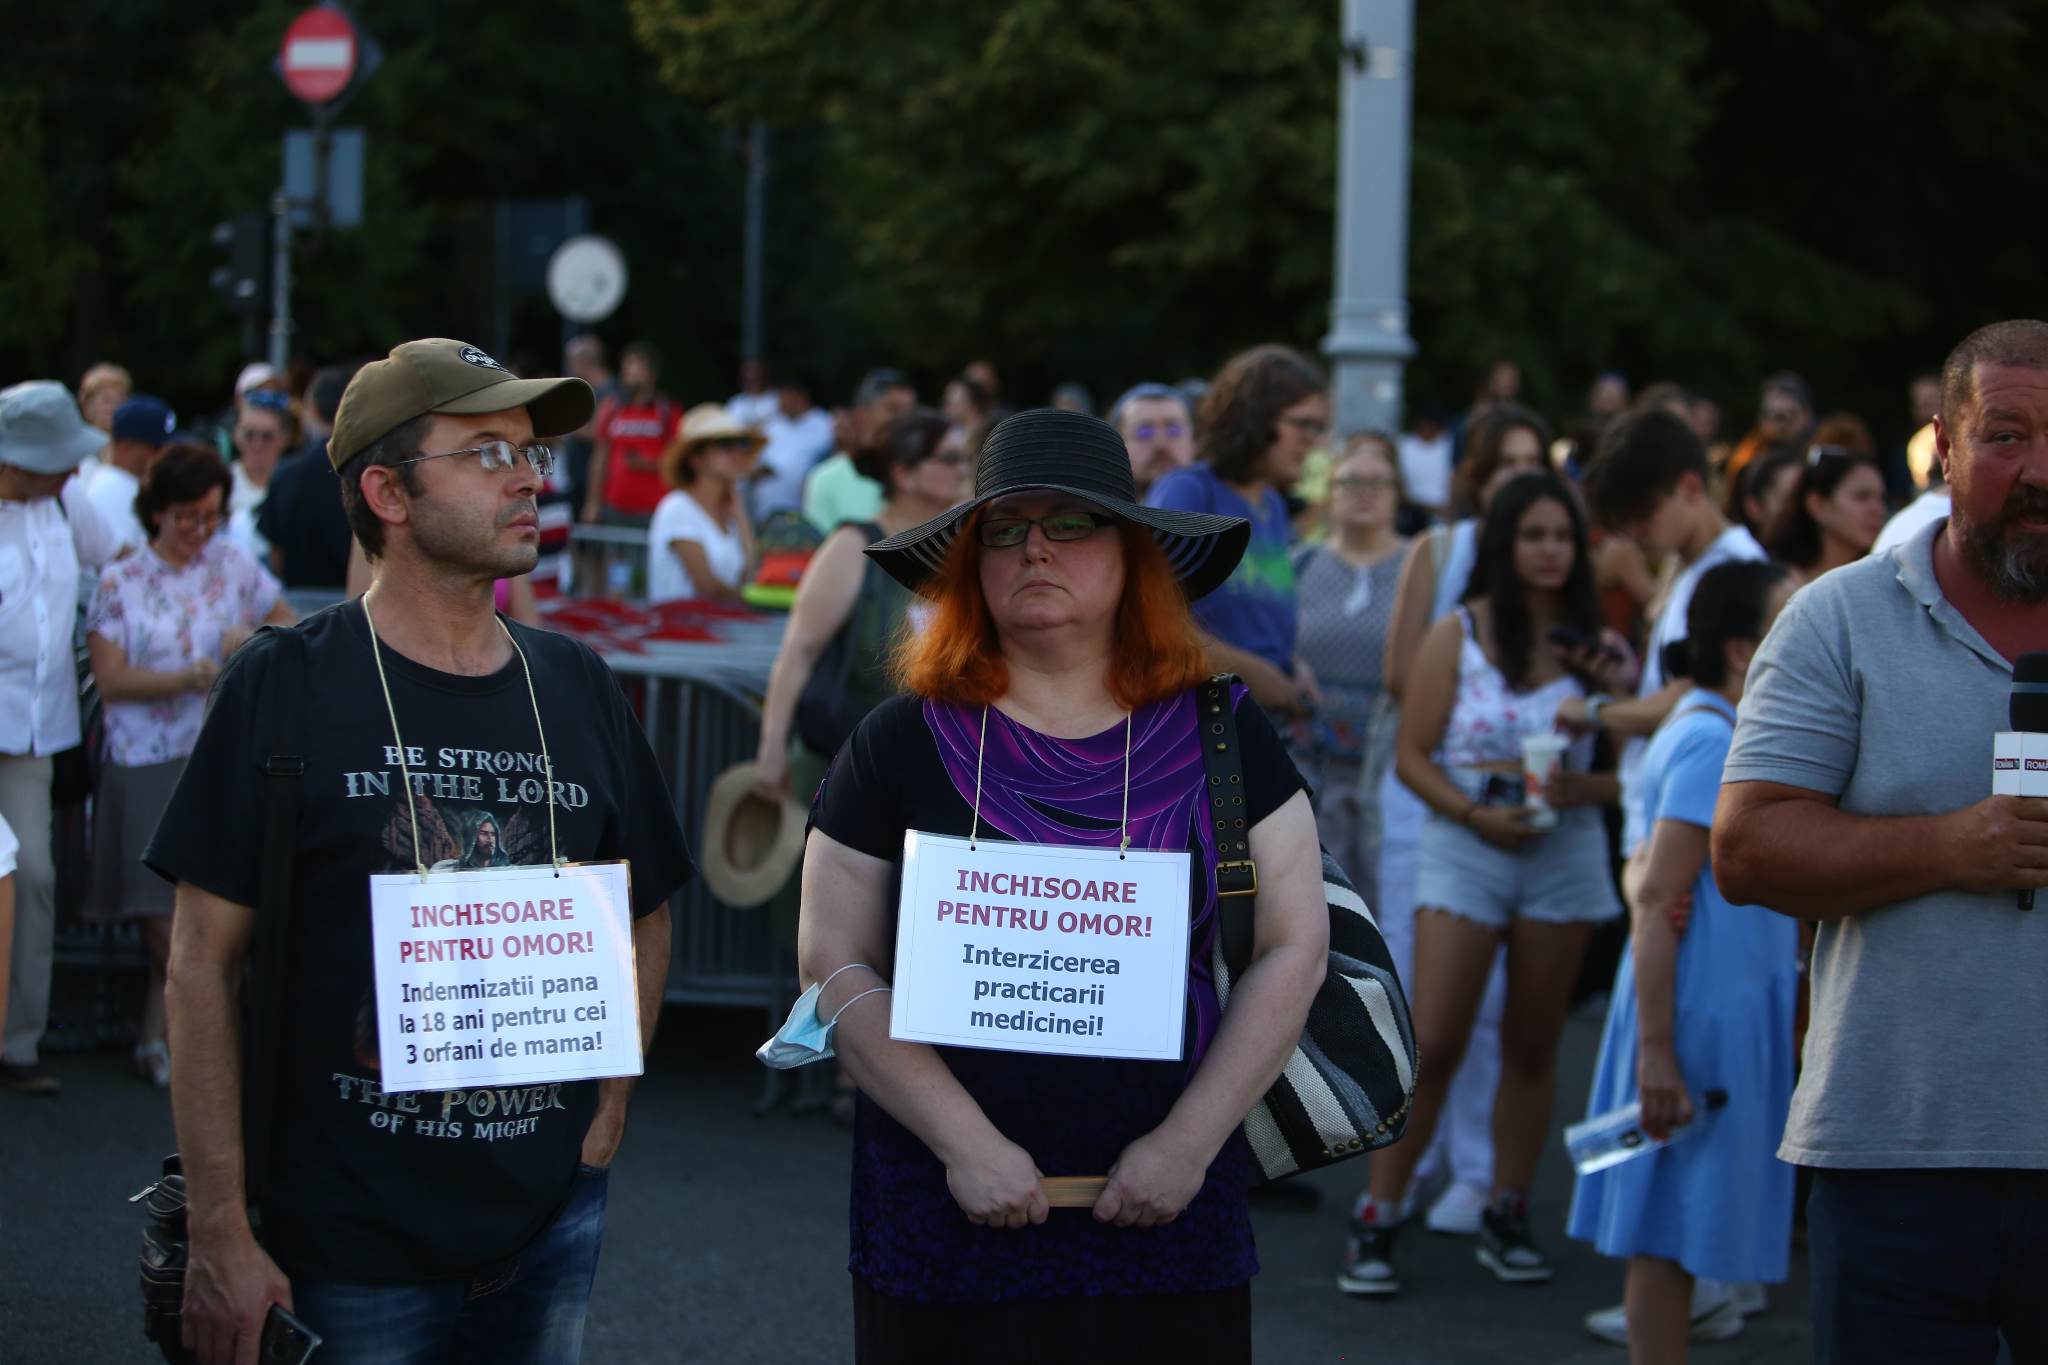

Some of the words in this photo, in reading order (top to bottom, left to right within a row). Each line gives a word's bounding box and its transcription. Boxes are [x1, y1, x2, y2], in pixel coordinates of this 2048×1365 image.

[383, 745, 427, 766] BE
[438, 747, 554, 779] STRONG
[344, 771, 391, 798] IN
[408, 772, 483, 800] THE
[495, 778, 588, 812] LORD
[956, 869, 1137, 903] INCHISOARE
[410, 898, 574, 928] INCHISOARE
[937, 900, 1048, 931] PENTRU
[1057, 911, 1152, 938] OMOR!
[400, 937, 493, 963] PENTRU
[503, 931, 594, 958] OMOR!
[962, 944, 1120, 974] Interzicerea
[402, 975, 534, 1003] Indenmizatii
[542, 975, 598, 998] pana
[974, 979, 1104, 1005] practicarii
[399, 1014, 415, 1034] la
[422, 1012, 445, 1032] 18
[453, 1009, 484, 1030] ani
[492, 1005, 566, 1032] pentru
[574, 1001, 606, 1022] cei
[970, 1010, 1103, 1036] medicinei!
[407, 1044, 417, 1064] 3
[424, 1039, 483, 1063] orfani
[490, 1038, 517, 1058] de
[525, 1031, 602, 1055] mama!
[370, 1111, 406, 1134] OF
[415, 1120, 463, 1138] HIS
[473, 1116, 540, 1143] MIGHT
